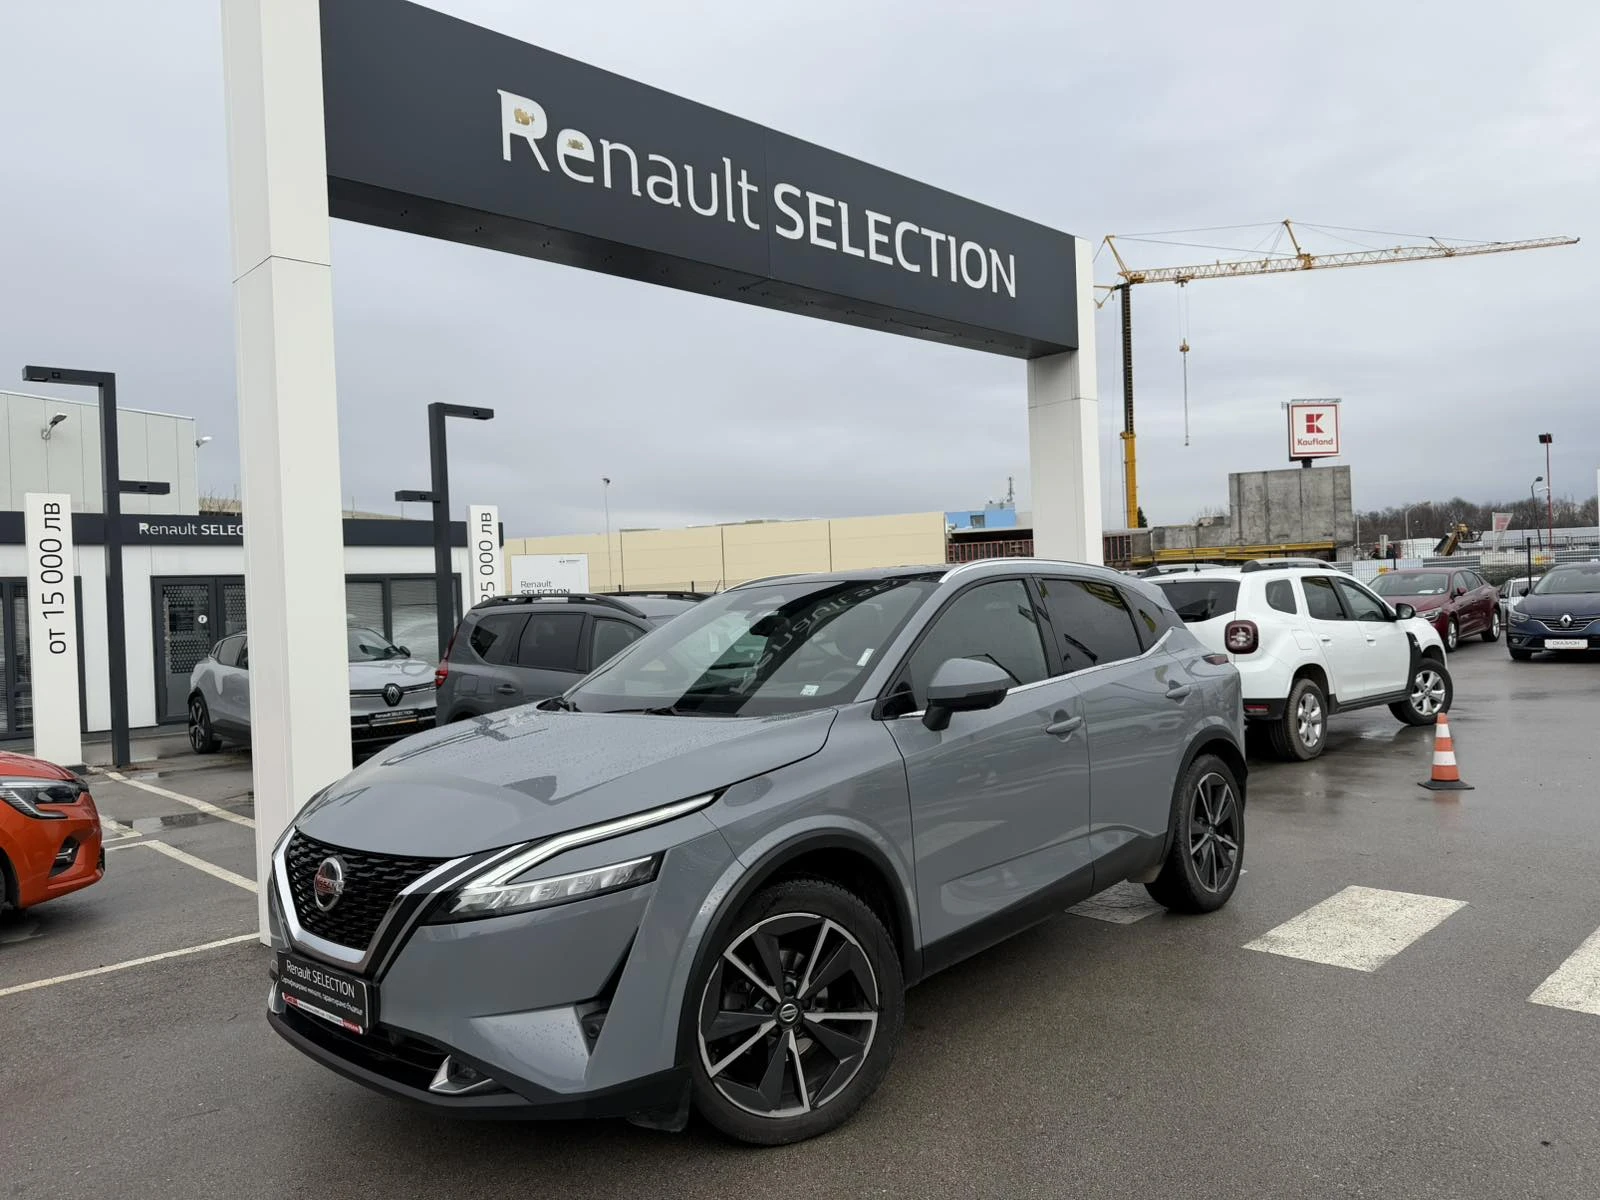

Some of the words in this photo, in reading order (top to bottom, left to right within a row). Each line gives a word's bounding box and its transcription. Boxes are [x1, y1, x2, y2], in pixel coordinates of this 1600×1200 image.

[497, 88, 760, 230] Renault
[773, 182, 1016, 298] SELECTION
[1297, 437, 1333, 446] Kaufland
[138, 522, 198, 535] Renault
[39, 538, 64, 584] 000
[478, 540, 494, 576] 000
[520, 580, 552, 588] Renault
[41, 592, 65, 620] 15
[286, 959, 312, 982] Renault
[312, 970, 355, 999] SELECTION
